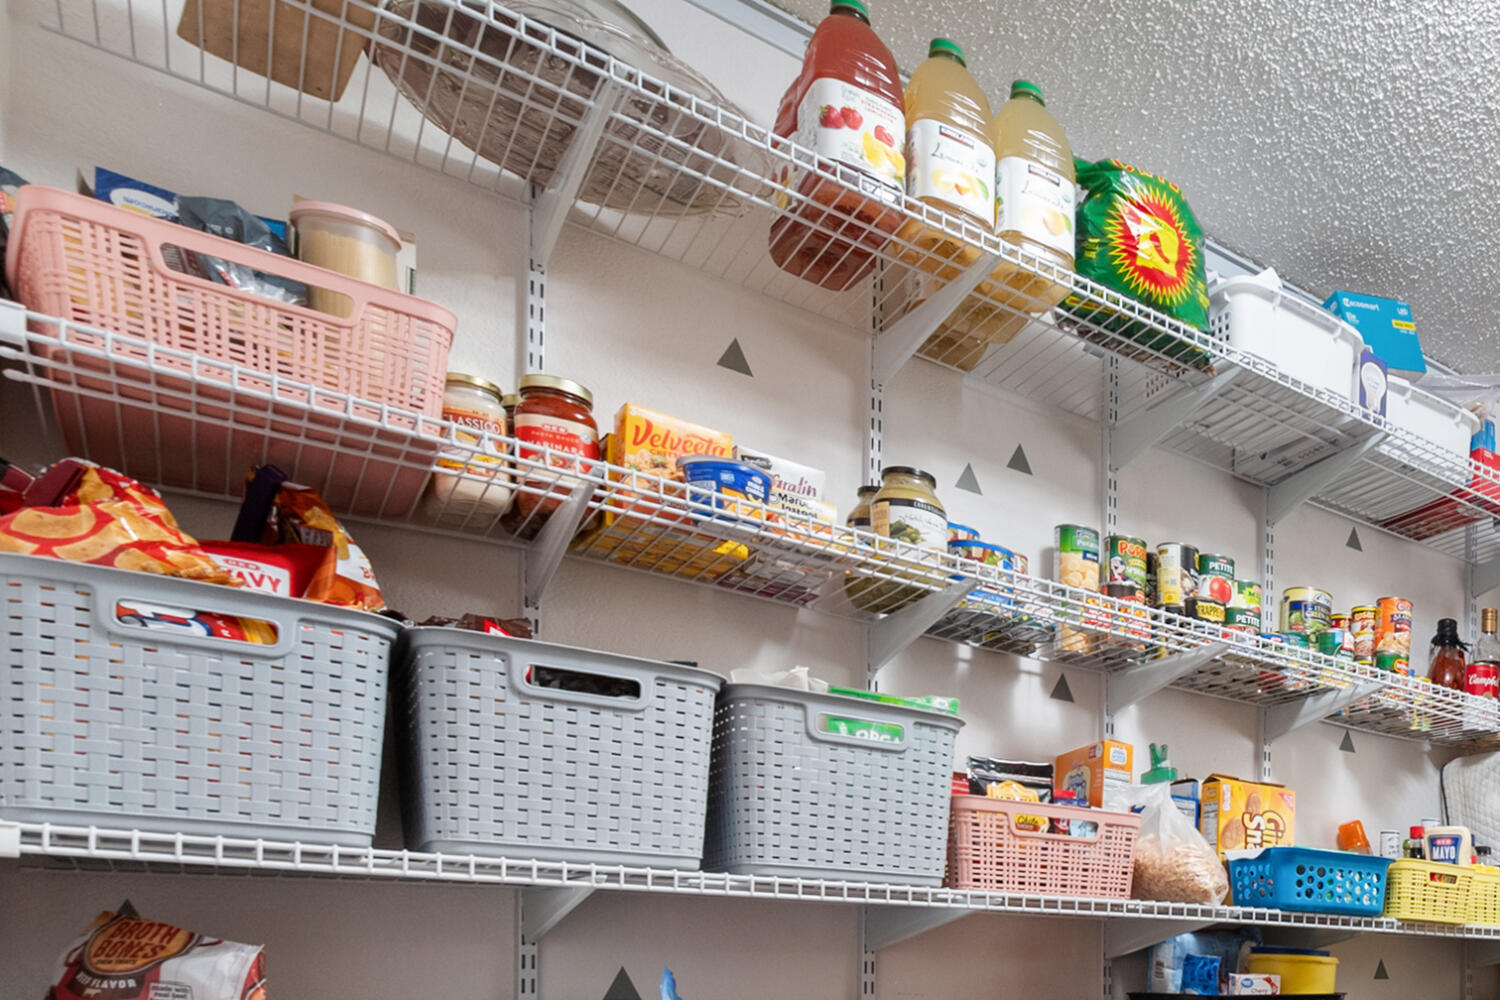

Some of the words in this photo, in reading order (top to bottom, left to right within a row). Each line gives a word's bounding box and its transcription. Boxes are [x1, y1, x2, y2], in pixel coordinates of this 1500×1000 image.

[632, 419, 726, 457] Velveeta
[1208, 561, 1234, 575] PETITE
[1235, 613, 1261, 628] PETITE
[1431, 845, 1456, 861] MAYO
[112, 920, 180, 943] BROTH
[94, 940, 166, 959] BONES
[94, 974, 137, 989] FLAVOR
